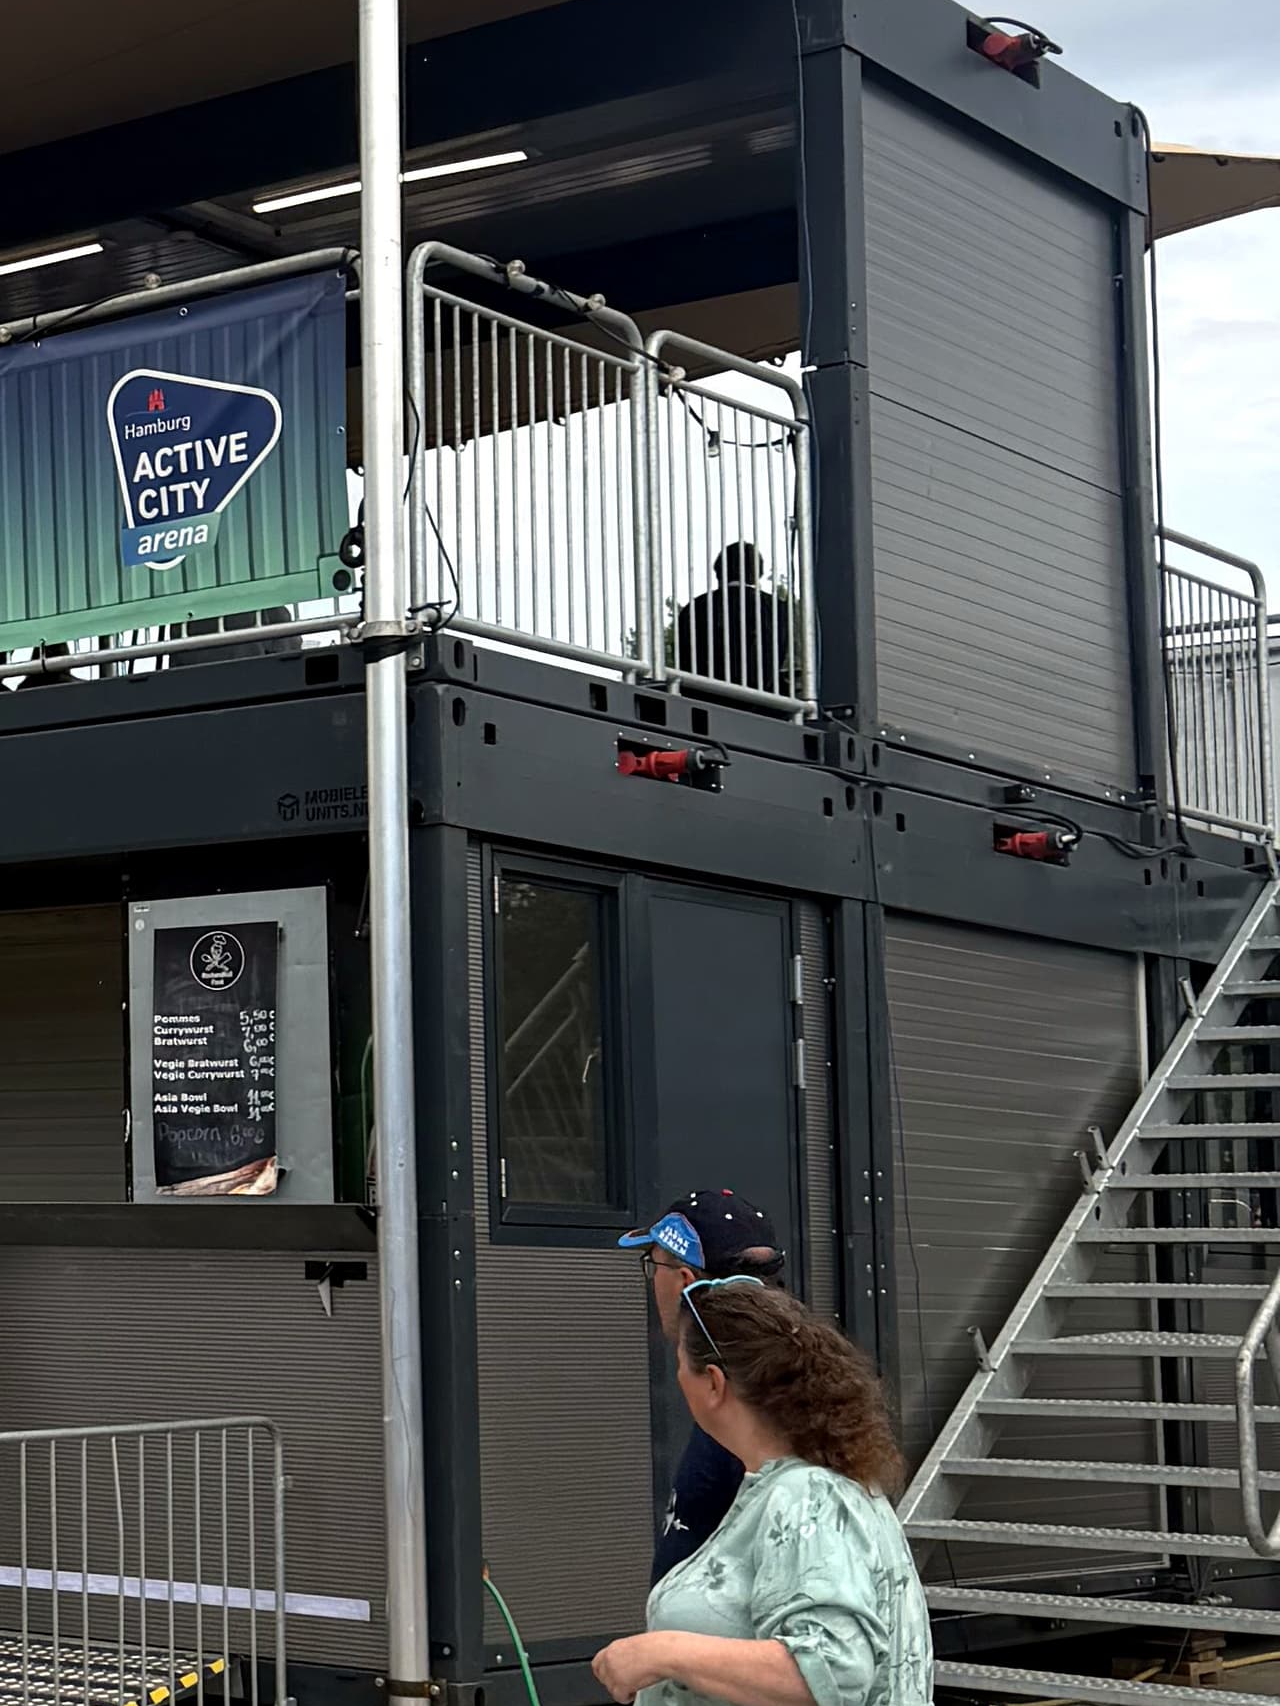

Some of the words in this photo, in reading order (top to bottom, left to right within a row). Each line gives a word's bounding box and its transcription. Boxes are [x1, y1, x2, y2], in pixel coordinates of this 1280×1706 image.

[124, 416, 191, 440] Hamburg
[133, 431, 249, 483] ACTIVE
[138, 477, 211, 520] CITY
[137, 524, 209, 556] arena
[153, 1014, 201, 1024] Pommes
[153, 1025, 214, 1036] Currywurst
[153, 1036, 208, 1046] Bratwurst
[153, 1059, 185, 1070] Vegie
[187, 1058, 239, 1068] Bratwurst
[153, 1070, 185, 1081] Vegie
[187, 1069, 245, 1081] Currywurst
[153, 1092, 178, 1102] Asia
[180, 1092, 208, 1102] Bowl
[153, 1104, 178, 1114] Asia
[213, 1102, 238, 1113] Bowl
[159, 1121, 222, 1149] Popcorn
